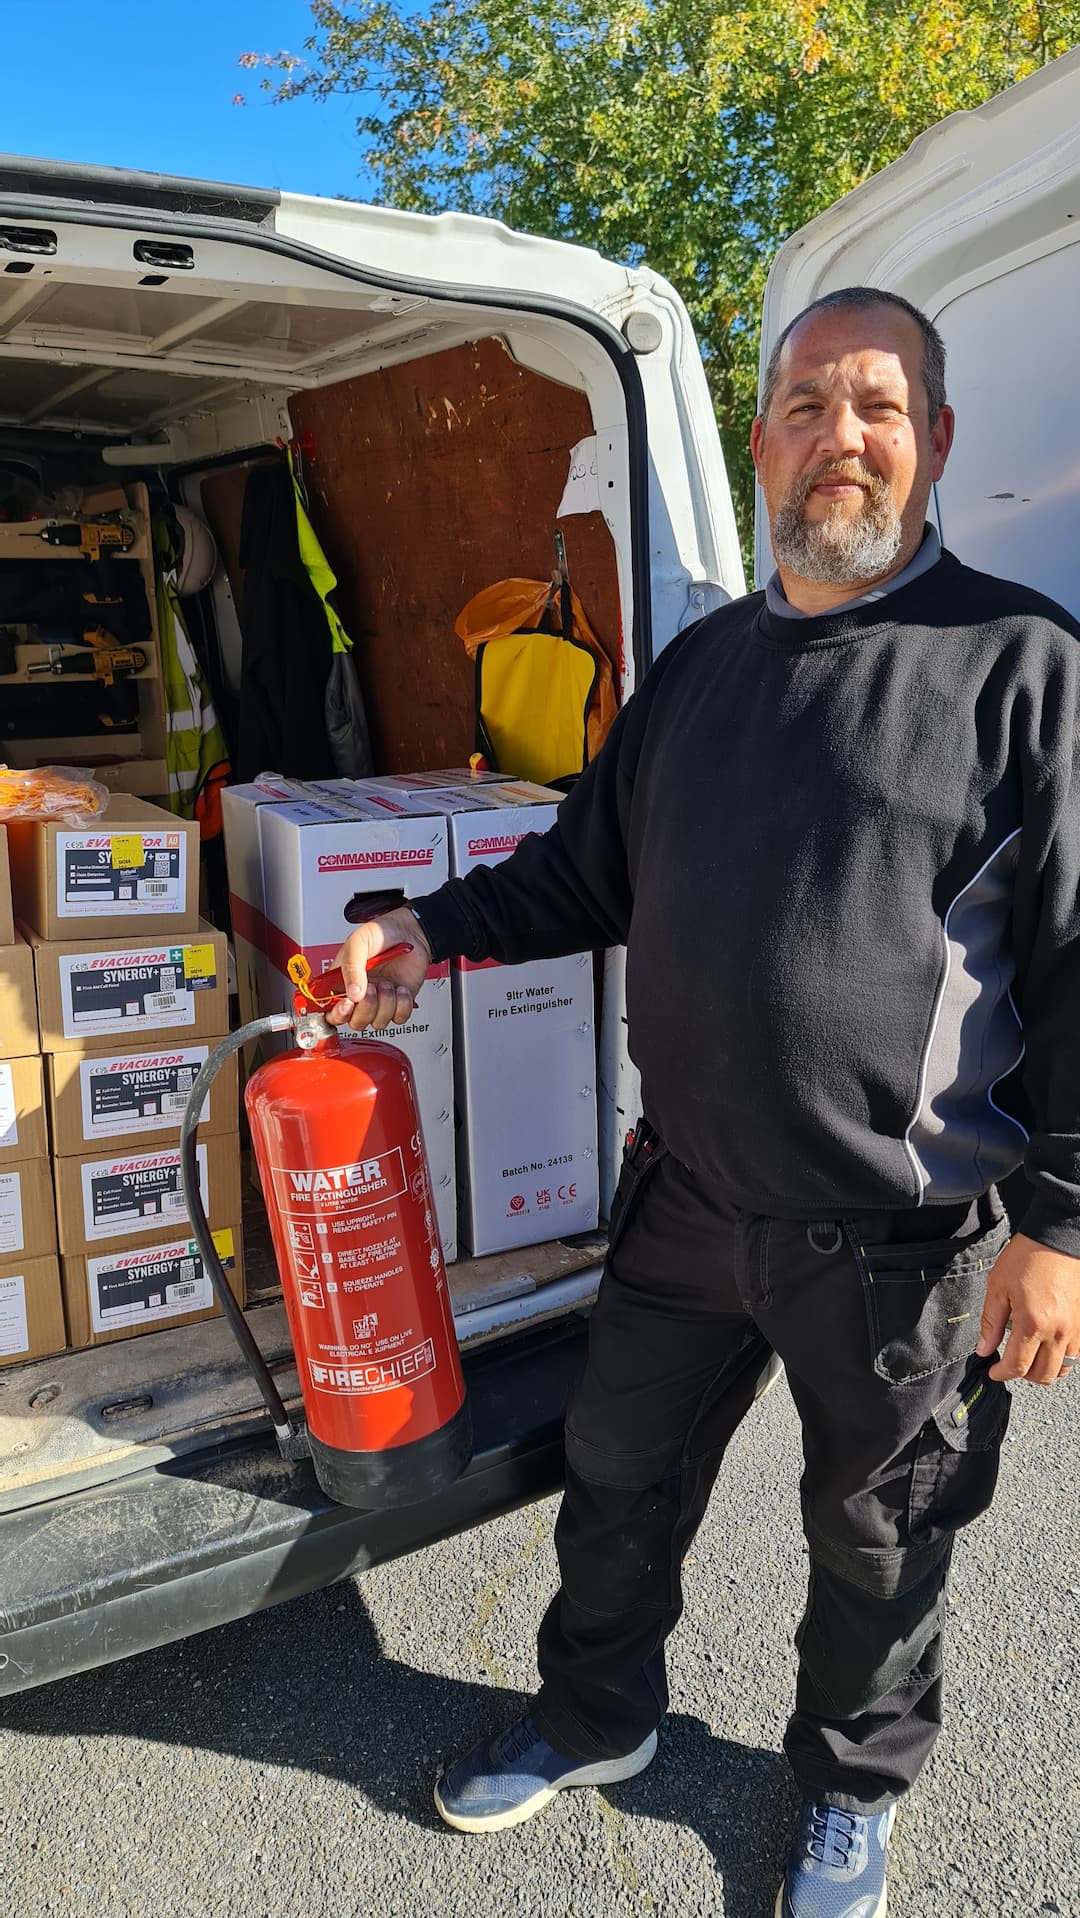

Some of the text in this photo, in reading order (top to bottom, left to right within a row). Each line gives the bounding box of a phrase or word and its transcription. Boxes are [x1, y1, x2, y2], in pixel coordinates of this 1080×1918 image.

[86, 838, 162, 848] EVAOR
[318, 848, 434, 866] COMMANDEREDGE
[90, 953, 166, 968] EVACUATOR
[104, 966, 159, 983] SYNERGY+
[506, 986, 554, 1000] 9ltr Water
[488, 998, 574, 1018] Fire Extinguisher
[362, 1024, 430, 1038] Extinguisher
[110, 1056, 184, 1072] EVACUATOR
[122, 1068, 177, 1085] SYNERGY+
[502, 1155, 573, 1178] Batch No. 24138
[123, 1167, 176, 1186] SYNERGY+
[290, 1160, 382, 1192] WATER
[290, 1178, 388, 1202] FIRE EXTINGUISHER
[558, 1183, 576, 1200] CE
[333, 1224, 360, 1234] REMOVE
[362, 1216, 386, 1230] SAFETY
[346, 1213, 376, 1226] UPRIGHT
[116, 1247, 186, 1268] EVACUATOR
[338, 1248, 361, 1258] DIRECT
[363, 1240, 388, 1252] NOZZLE
[338, 1256, 356, 1264] BASE
[368, 1249, 382, 1257] FIRE
[384, 1241, 401, 1252] FROM
[349, 1258, 369, 1268] LEAST
[376, 1250, 398, 1262] METRE
[128, 1260, 179, 1280] SYNERGY+
[343, 1265, 403, 1288] SQUEEZE HANDLES
[354, 1279, 385, 1292] OPERATE
[375, 1338, 388, 1346] USE
[390, 1334, 399, 1343] ON
[400, 1328, 413, 1340] LIVE
[330, 1349, 367, 1358] ELECTRICAL
[312, 1347, 424, 1387] FIRECHIEF
